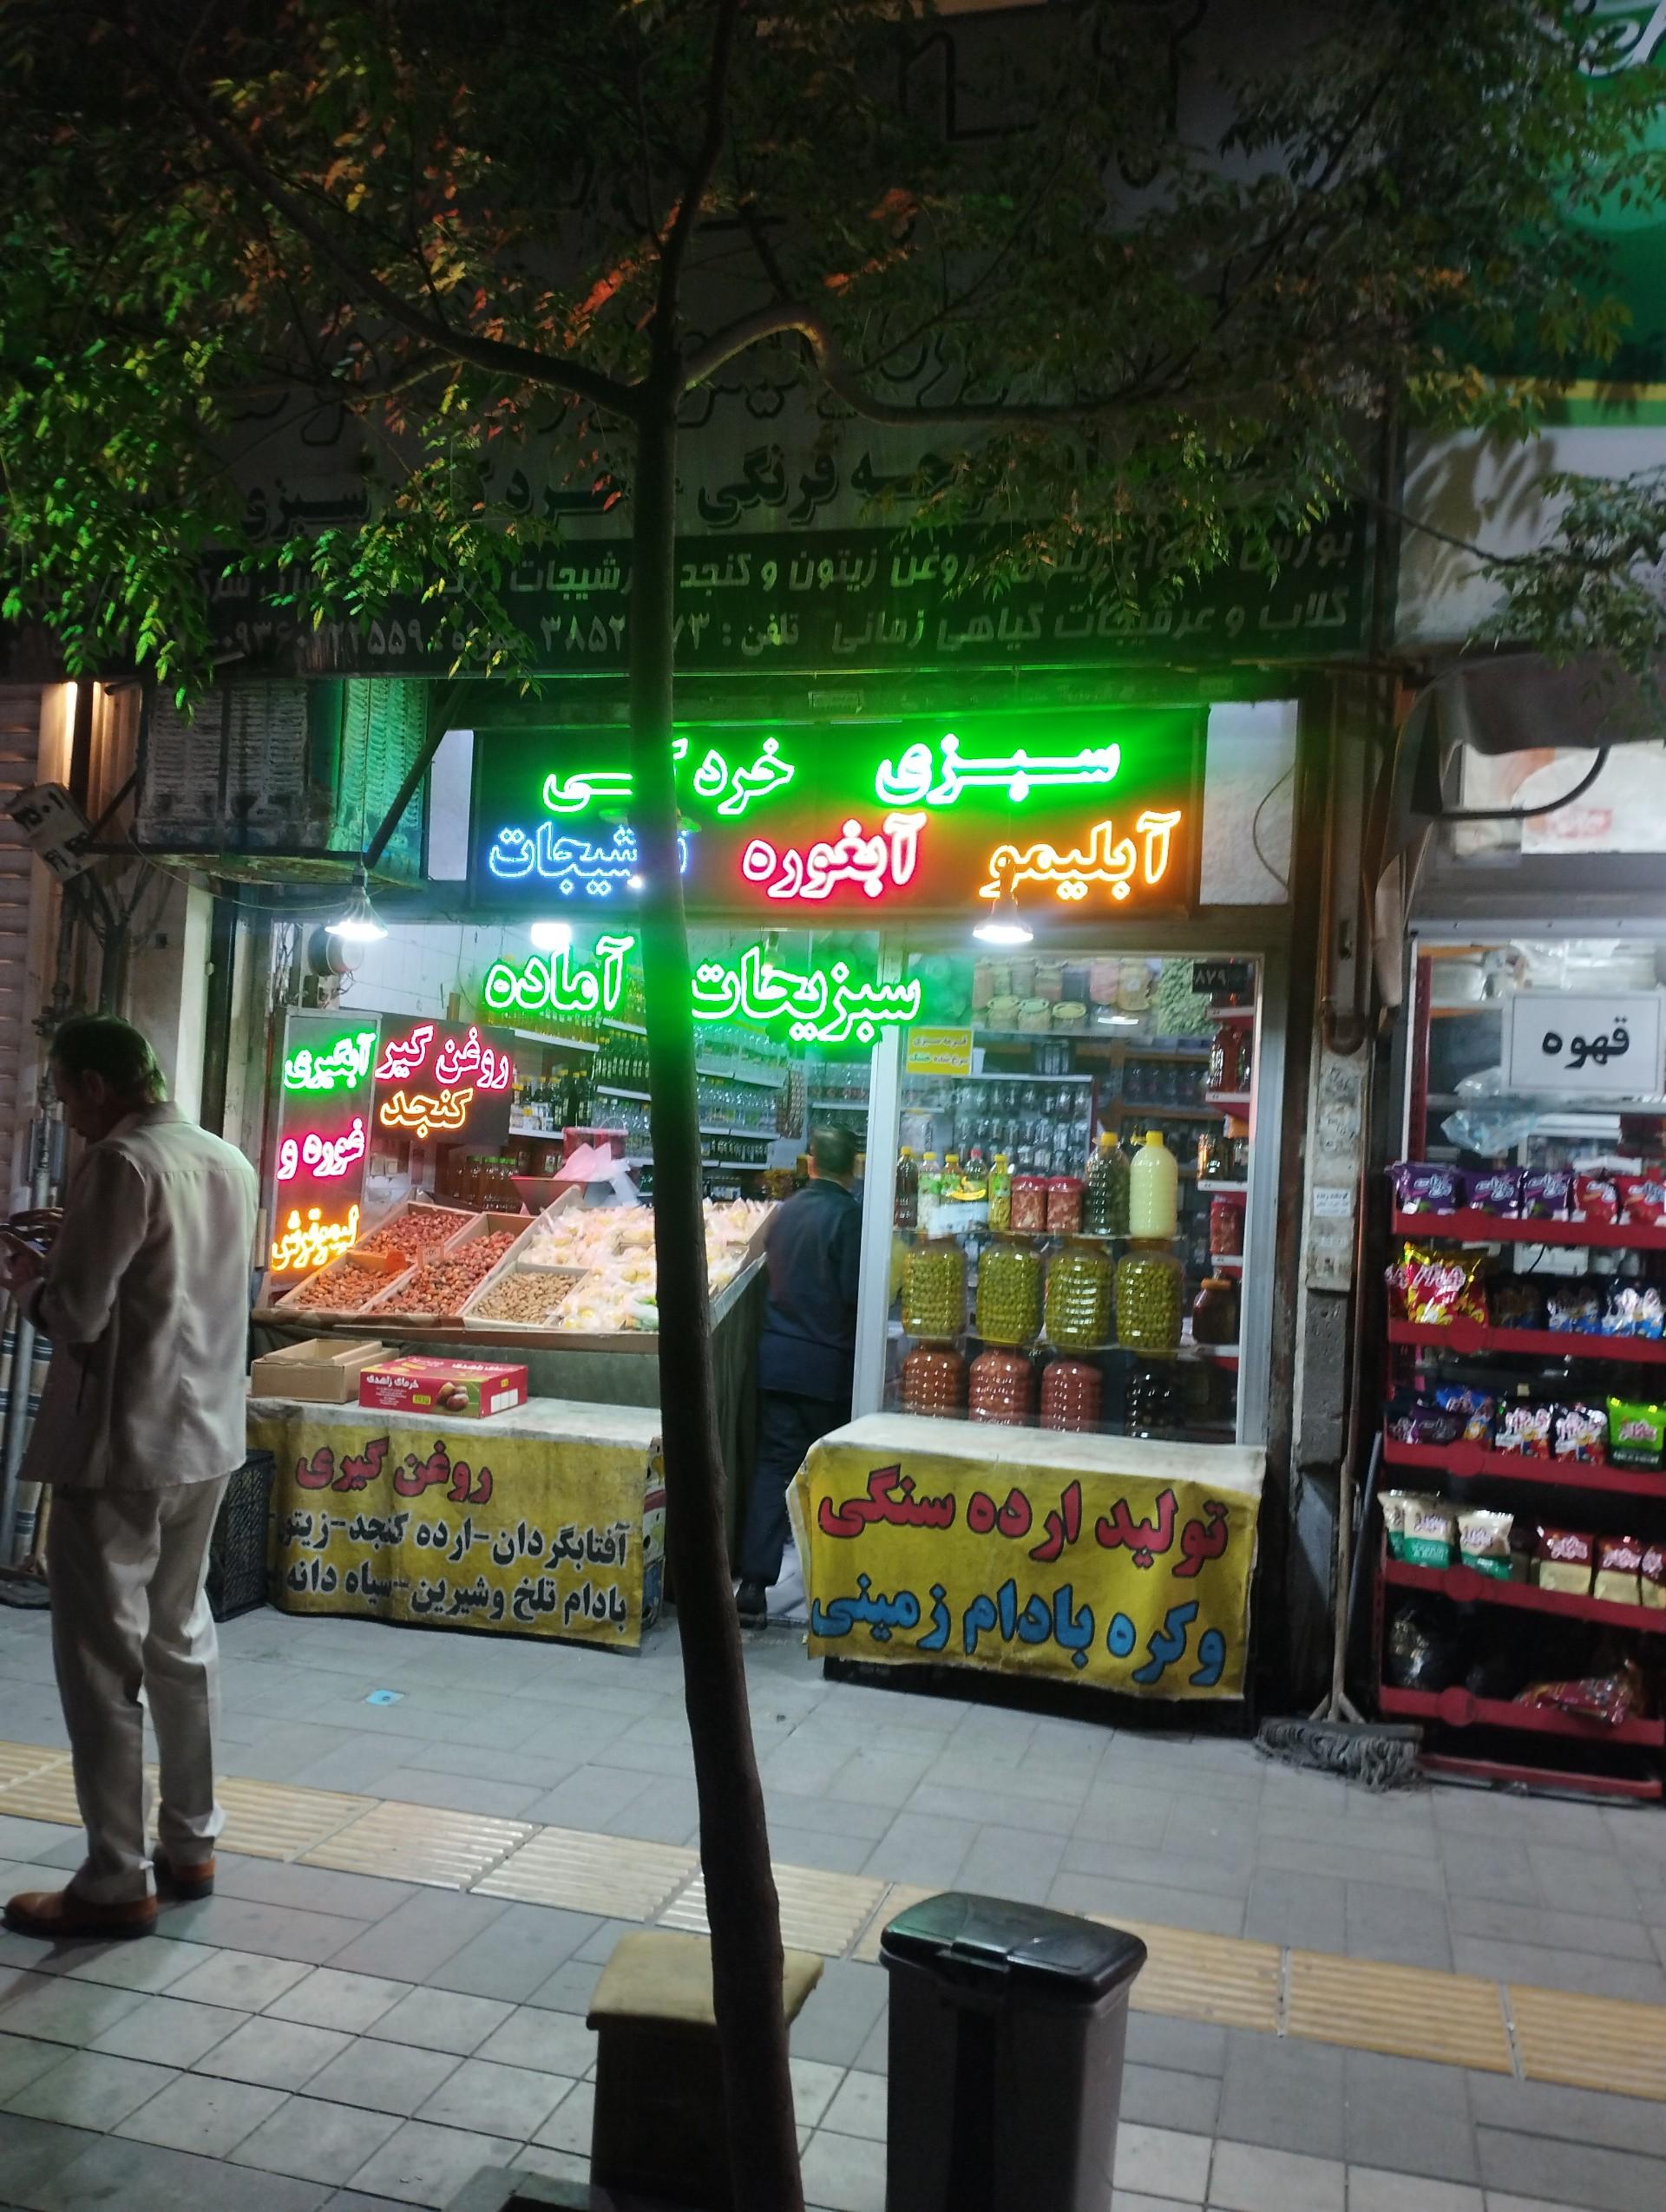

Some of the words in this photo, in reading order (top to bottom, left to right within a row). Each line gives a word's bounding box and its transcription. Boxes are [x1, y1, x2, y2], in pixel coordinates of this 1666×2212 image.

[509, 550, 633, 601] رشیجات
[679, 553, 751, 597] کنجد
[760, 560, 778, 592] و
[788, 547, 878, 592] زیتون
[889, 546, 975, 589] روغن
[1224, 605, 1246, 639] و
[1258, 586, 1350, 642] گلاب
[693, 736, 796, 815] خرد
[874, 733, 1121, 805] سبزی
[742, 811, 929, 900] آبغوره
[979, 810, 1182, 900] آبلیمو
[485, 933, 636, 1013] آماده
[690, 946, 922, 1044] سبزیجات
[436, 1026, 509, 1090] روغن
[1541, 1016, 1630, 1070] قهوه
[379, 1088, 474, 1139] کنجد
[277, 1138, 298, 1181] و
[302, 1117, 365, 1177] غوره
[296, 1436, 390, 1492] گیری
[393, 1439, 494, 1504] روغن
[818, 1463, 955, 1538] سنگی
[966, 1478, 1083, 1562] ارده
[1094, 1489, 1229, 1578] تولید
[287, 1557, 337, 1592] دانه
[513, 1576, 556, 1621] تلخ
[564, 1582, 626, 1633] بادام
[810, 1573, 951, 1652] زمینی
[962, 1577, 1096, 1669] بادام
